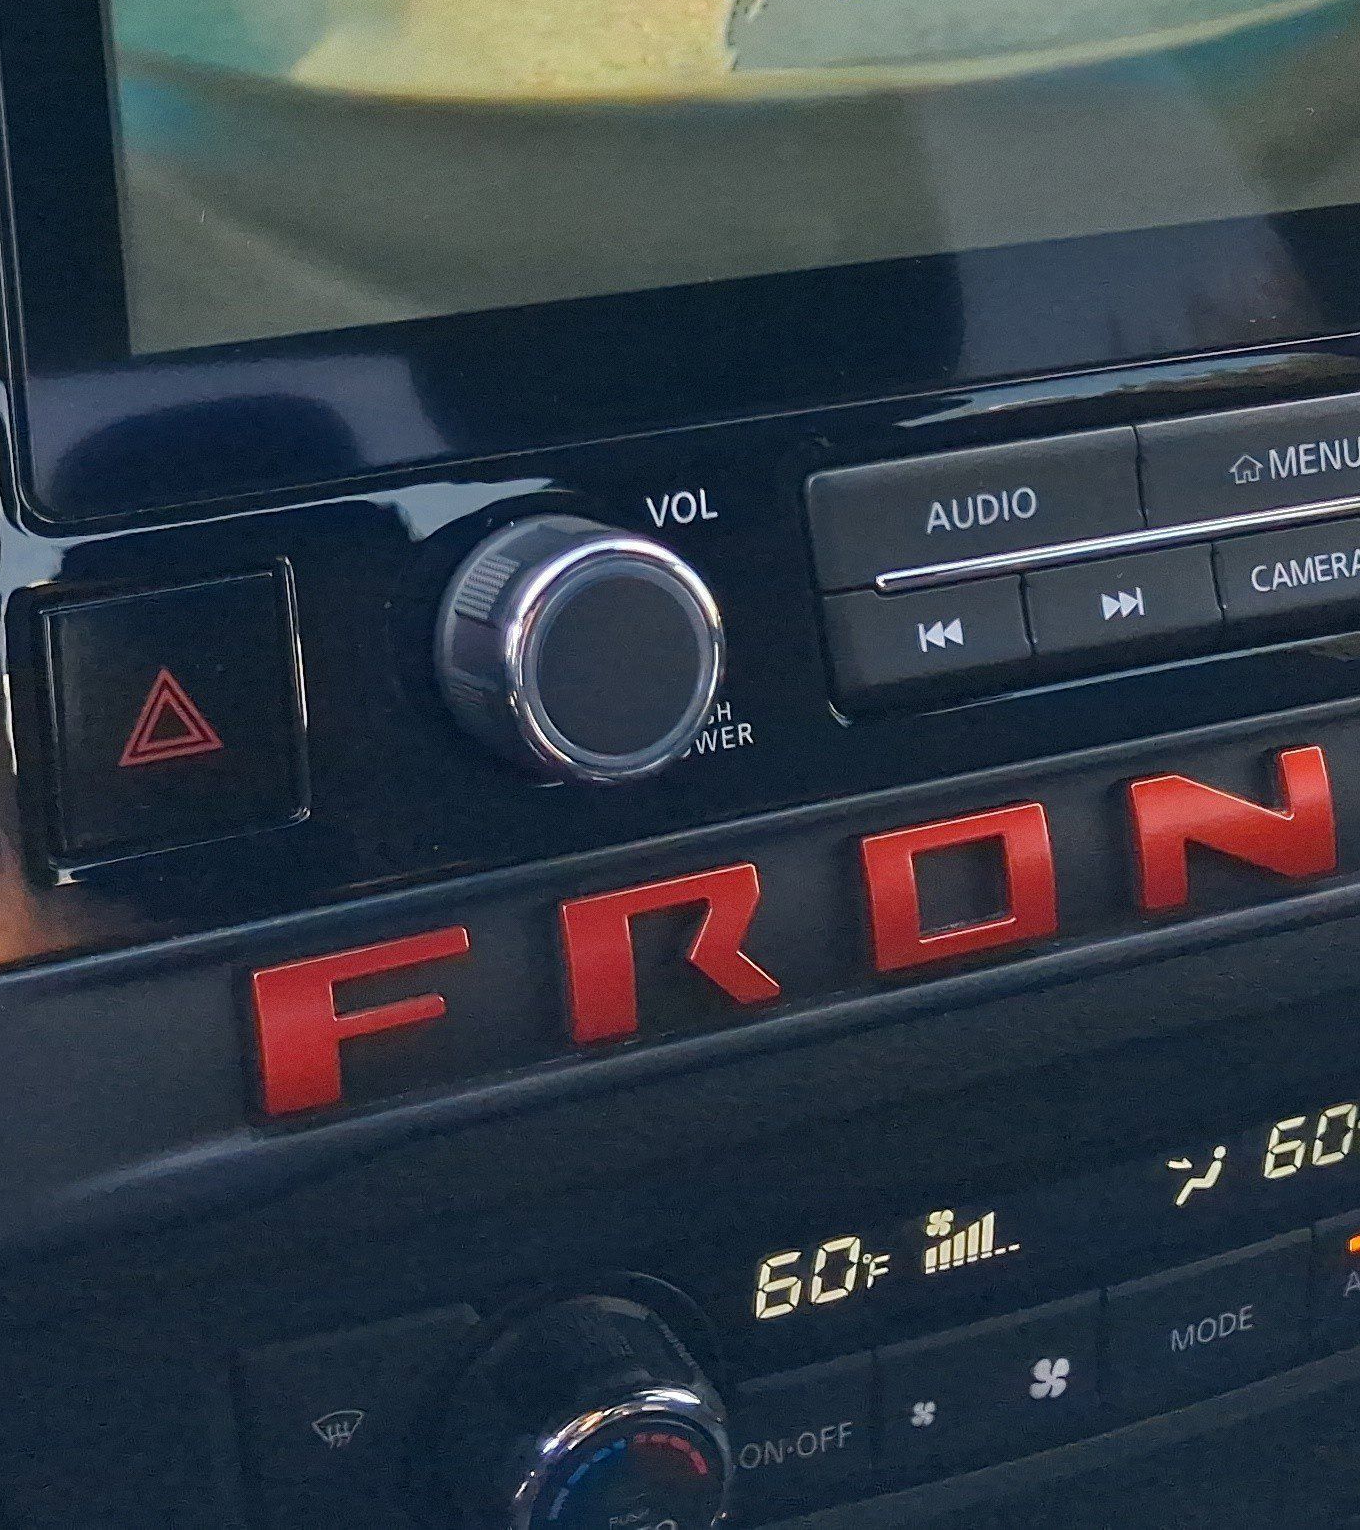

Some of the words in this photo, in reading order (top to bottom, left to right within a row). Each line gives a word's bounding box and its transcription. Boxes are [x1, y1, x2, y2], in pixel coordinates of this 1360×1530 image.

[645, 488, 718, 528] VOL
[925, 486, 1038, 535] AUDIO
[1169, 1305, 1256, 1351] MODE
